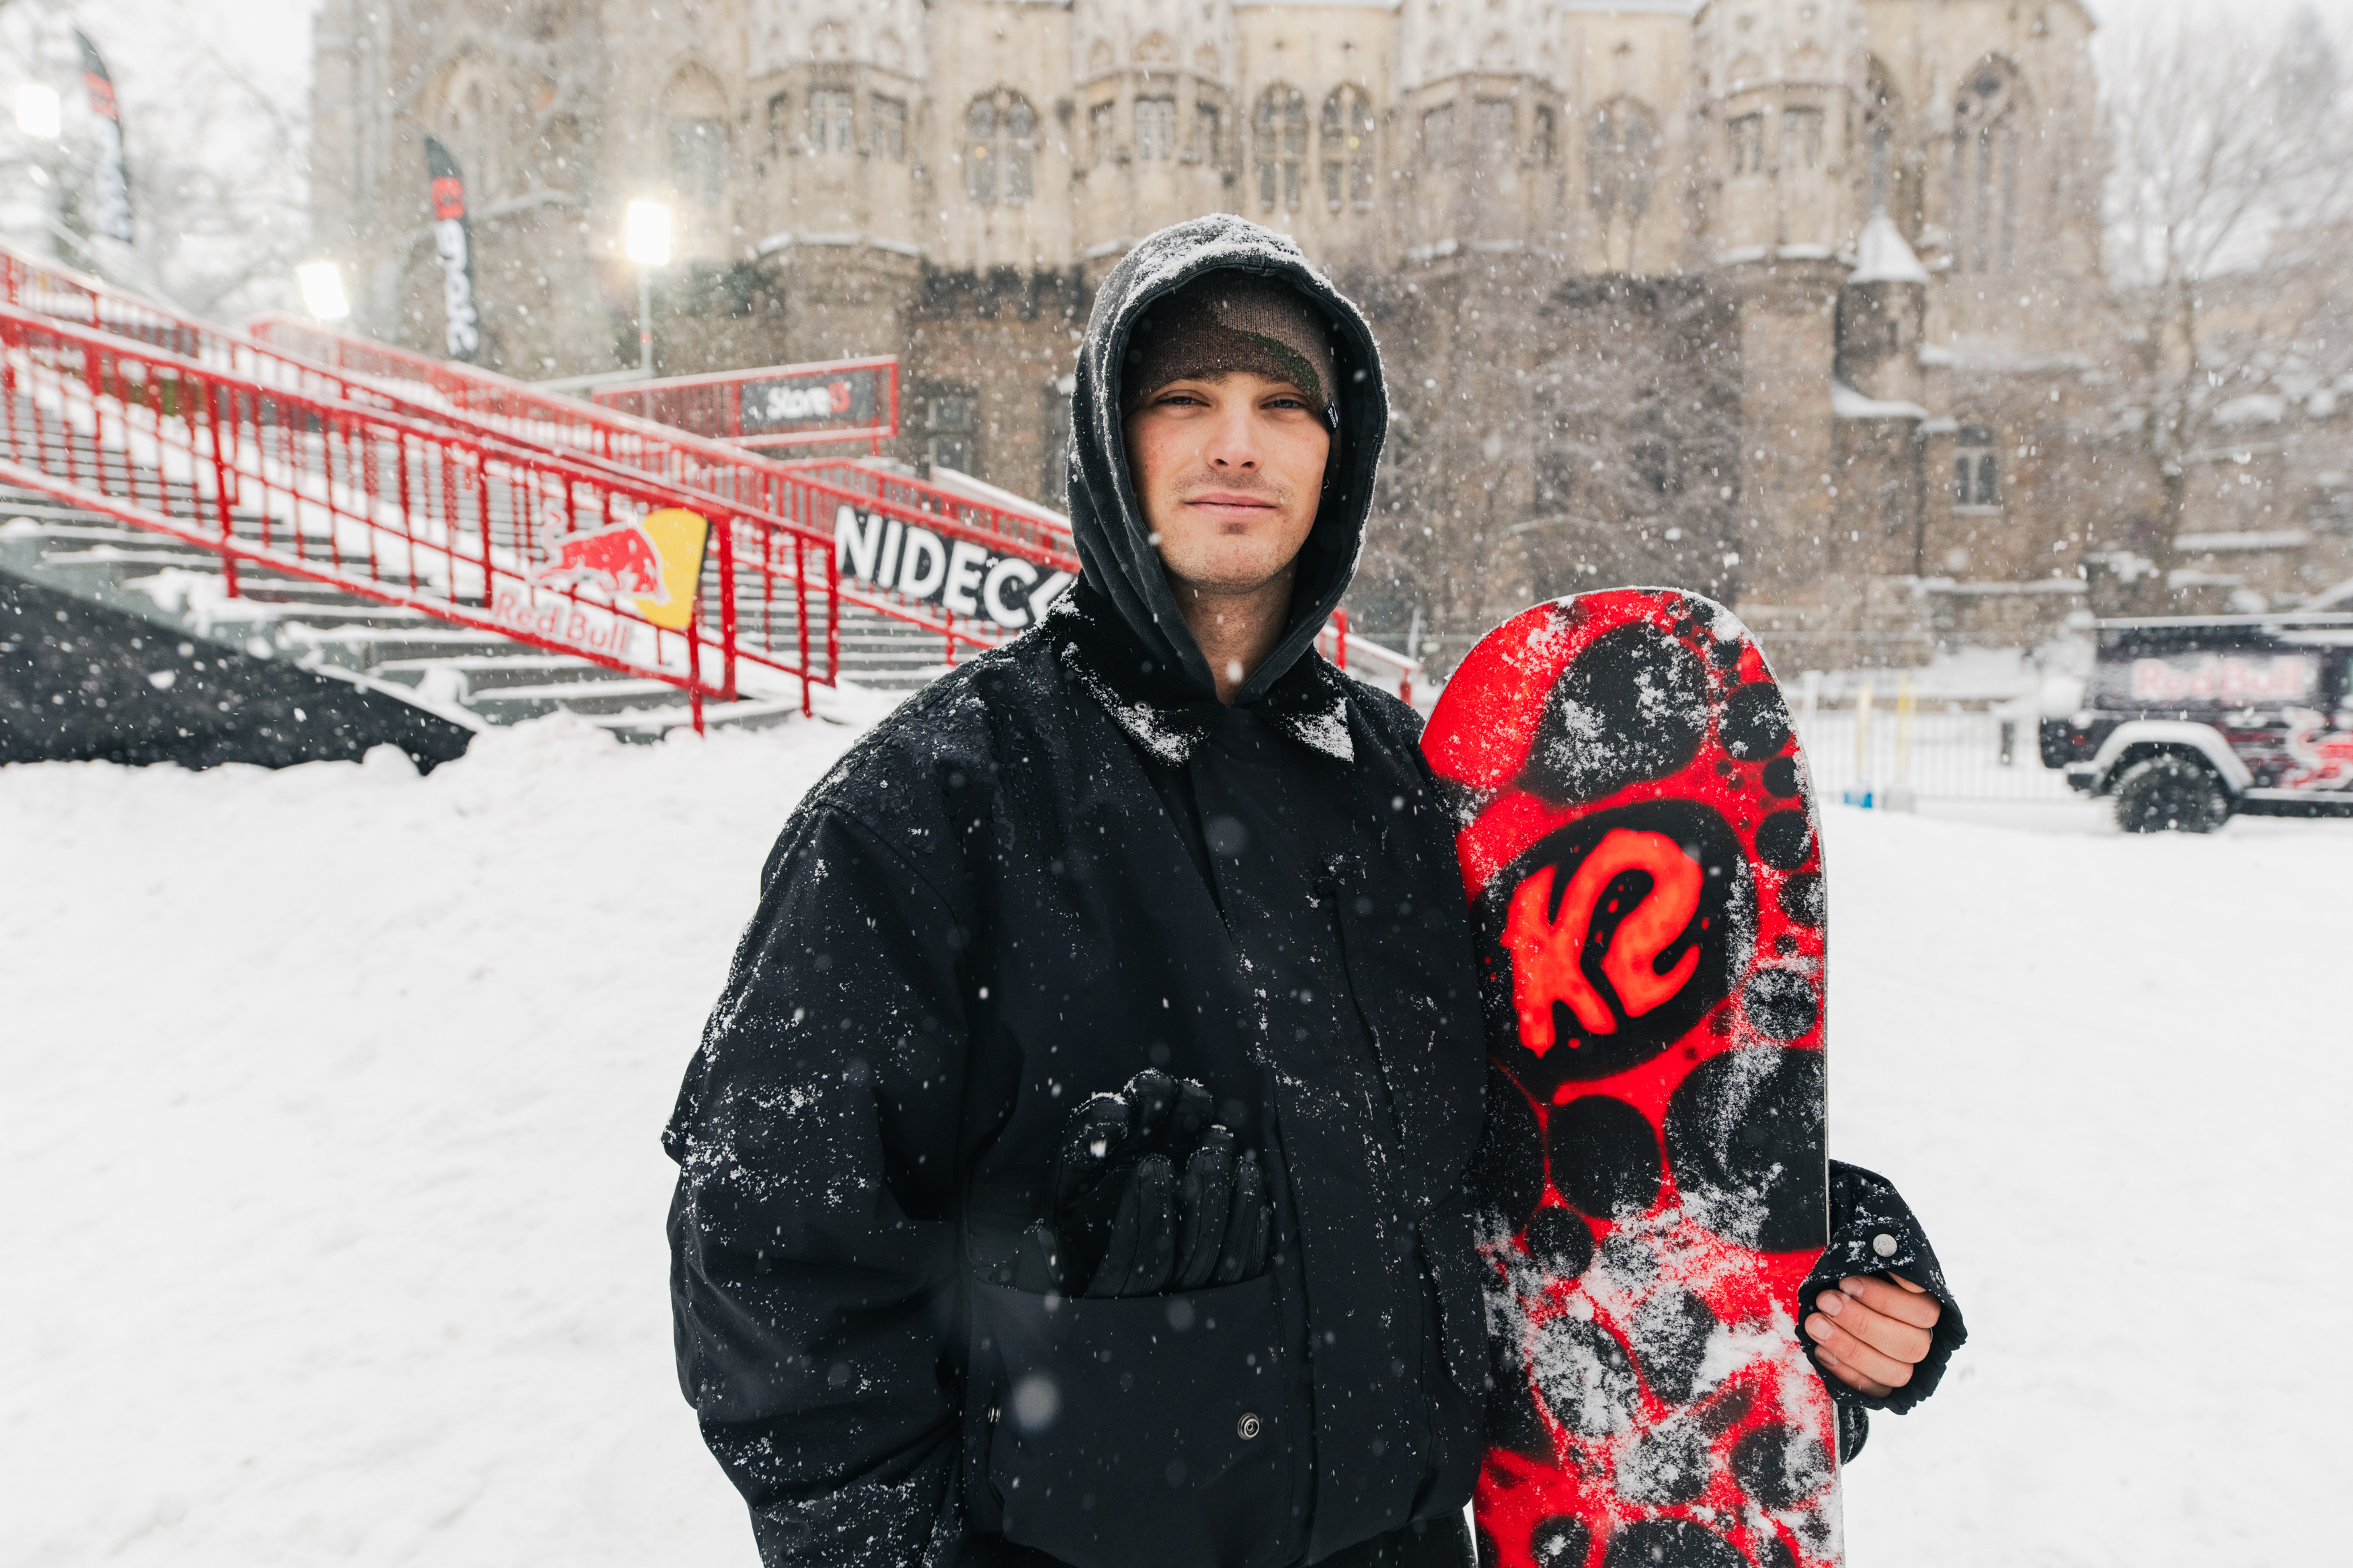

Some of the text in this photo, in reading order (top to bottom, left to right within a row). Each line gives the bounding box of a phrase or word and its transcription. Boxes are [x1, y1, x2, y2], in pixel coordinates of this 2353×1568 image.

[495, 592, 629, 653] Red Bull
[2135, 656, 2304, 695] Red Bull
[1500, 827, 1703, 1058] K2
